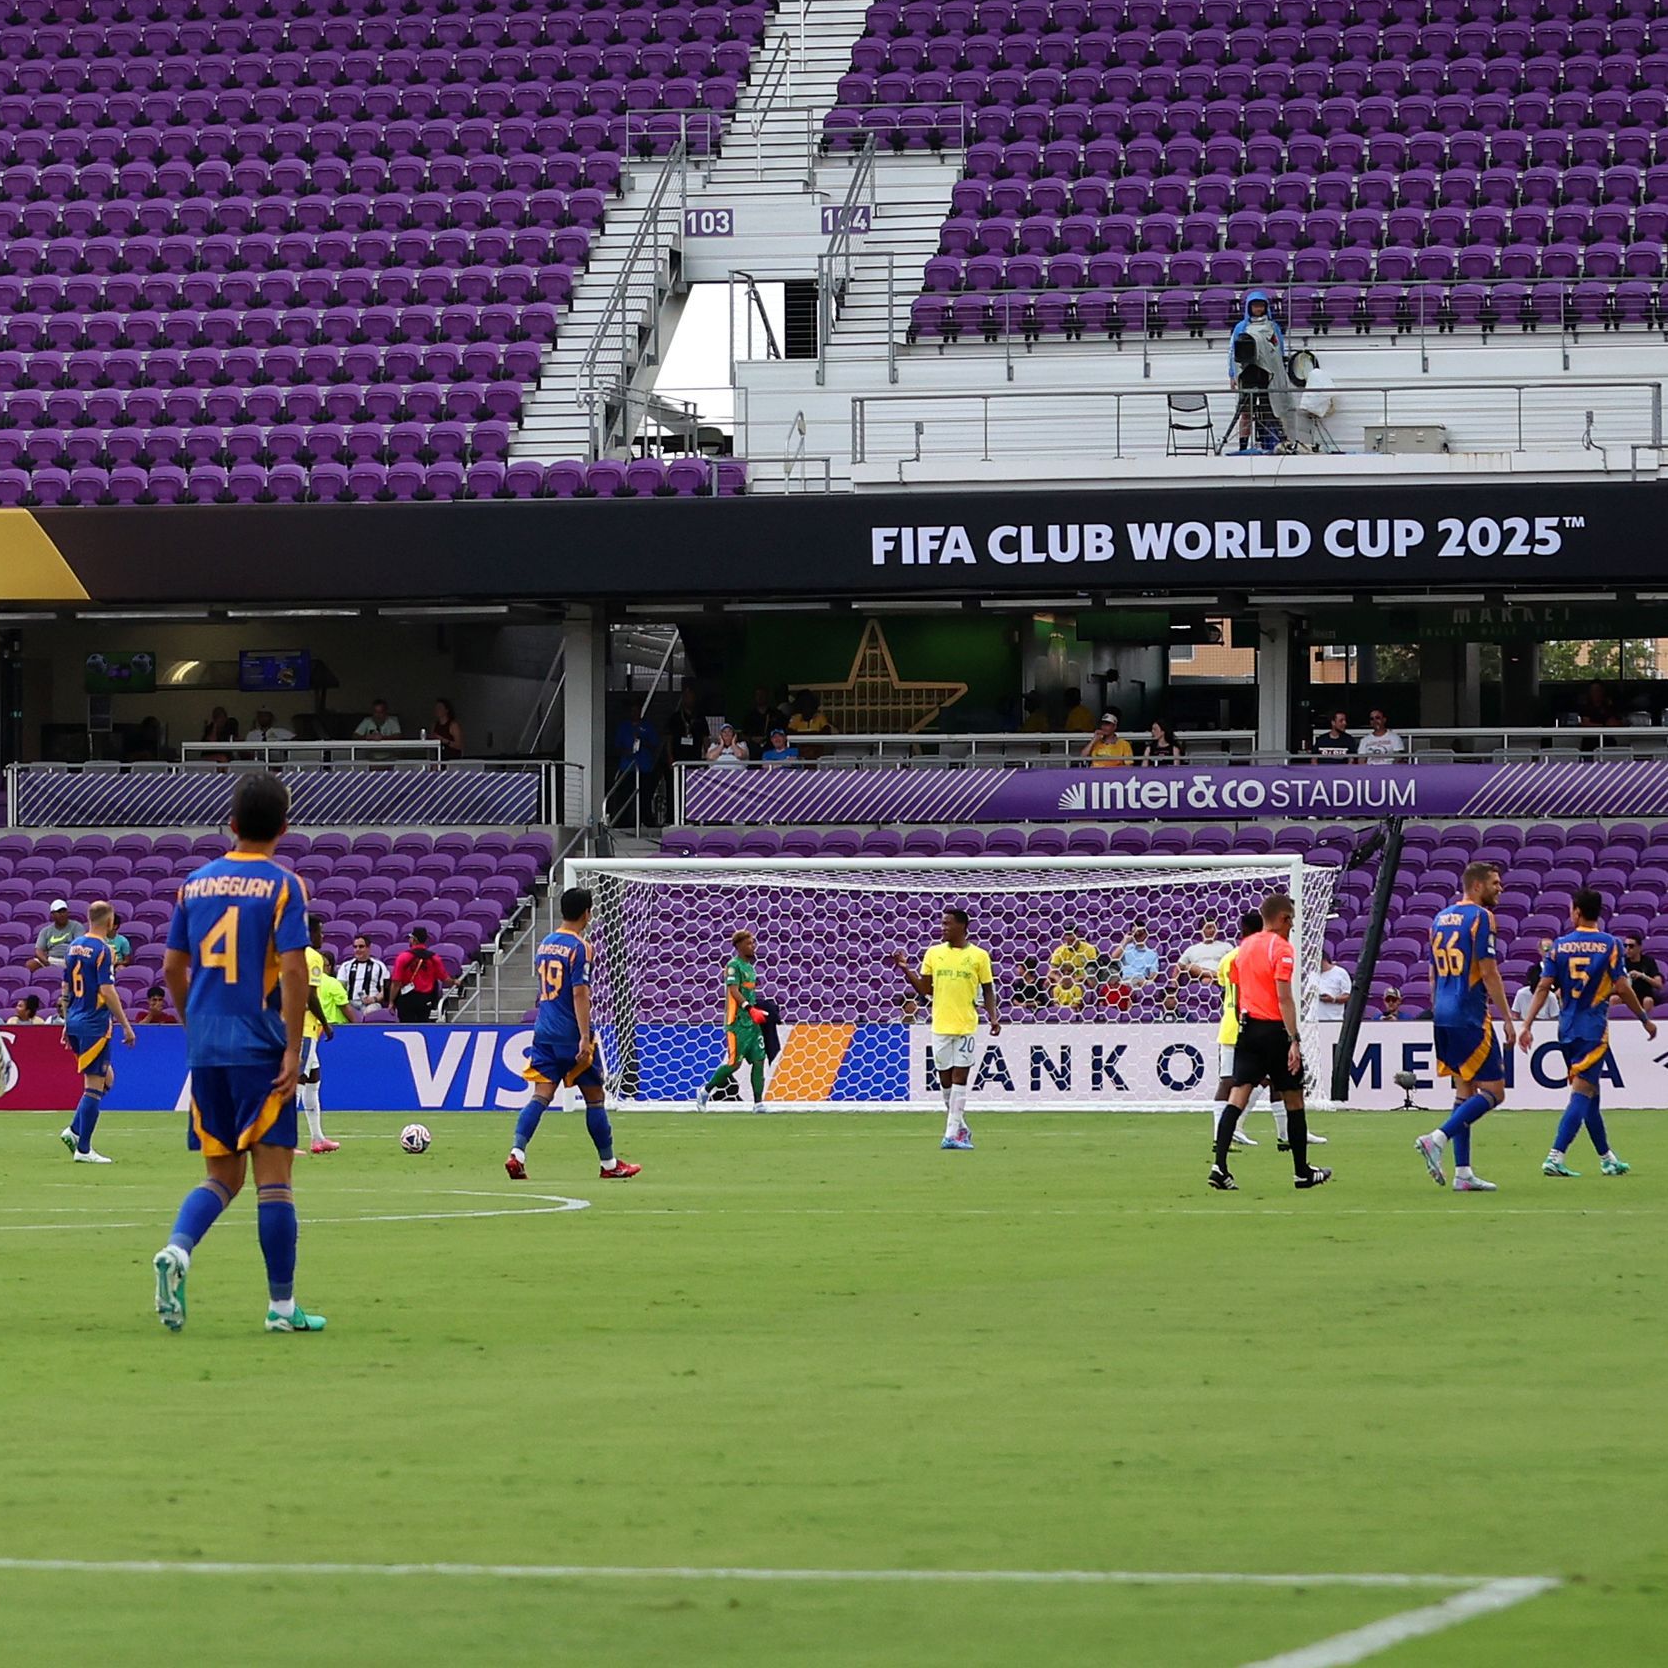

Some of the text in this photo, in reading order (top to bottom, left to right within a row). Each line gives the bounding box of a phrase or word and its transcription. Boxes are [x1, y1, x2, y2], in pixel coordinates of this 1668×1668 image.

[687, 210, 730, 234] 103
[871, 526, 977, 565] FIFA
[987, 524, 1115, 564] CLUB
[1126, 520, 1311, 561] WORLD
[1323, 519, 1425, 558] CUP
[1270, 779, 1416, 807] STADIUM
[200, 905, 240, 985] 4
[1432, 931, 1465, 978] 66
[72, 959, 84, 999] 6
[538, 959, 564, 1001] 19
[1568, 956, 1591, 999] 5
[958, 1035, 976, 1053] 20
[383, 1031, 564, 1108] VIS
